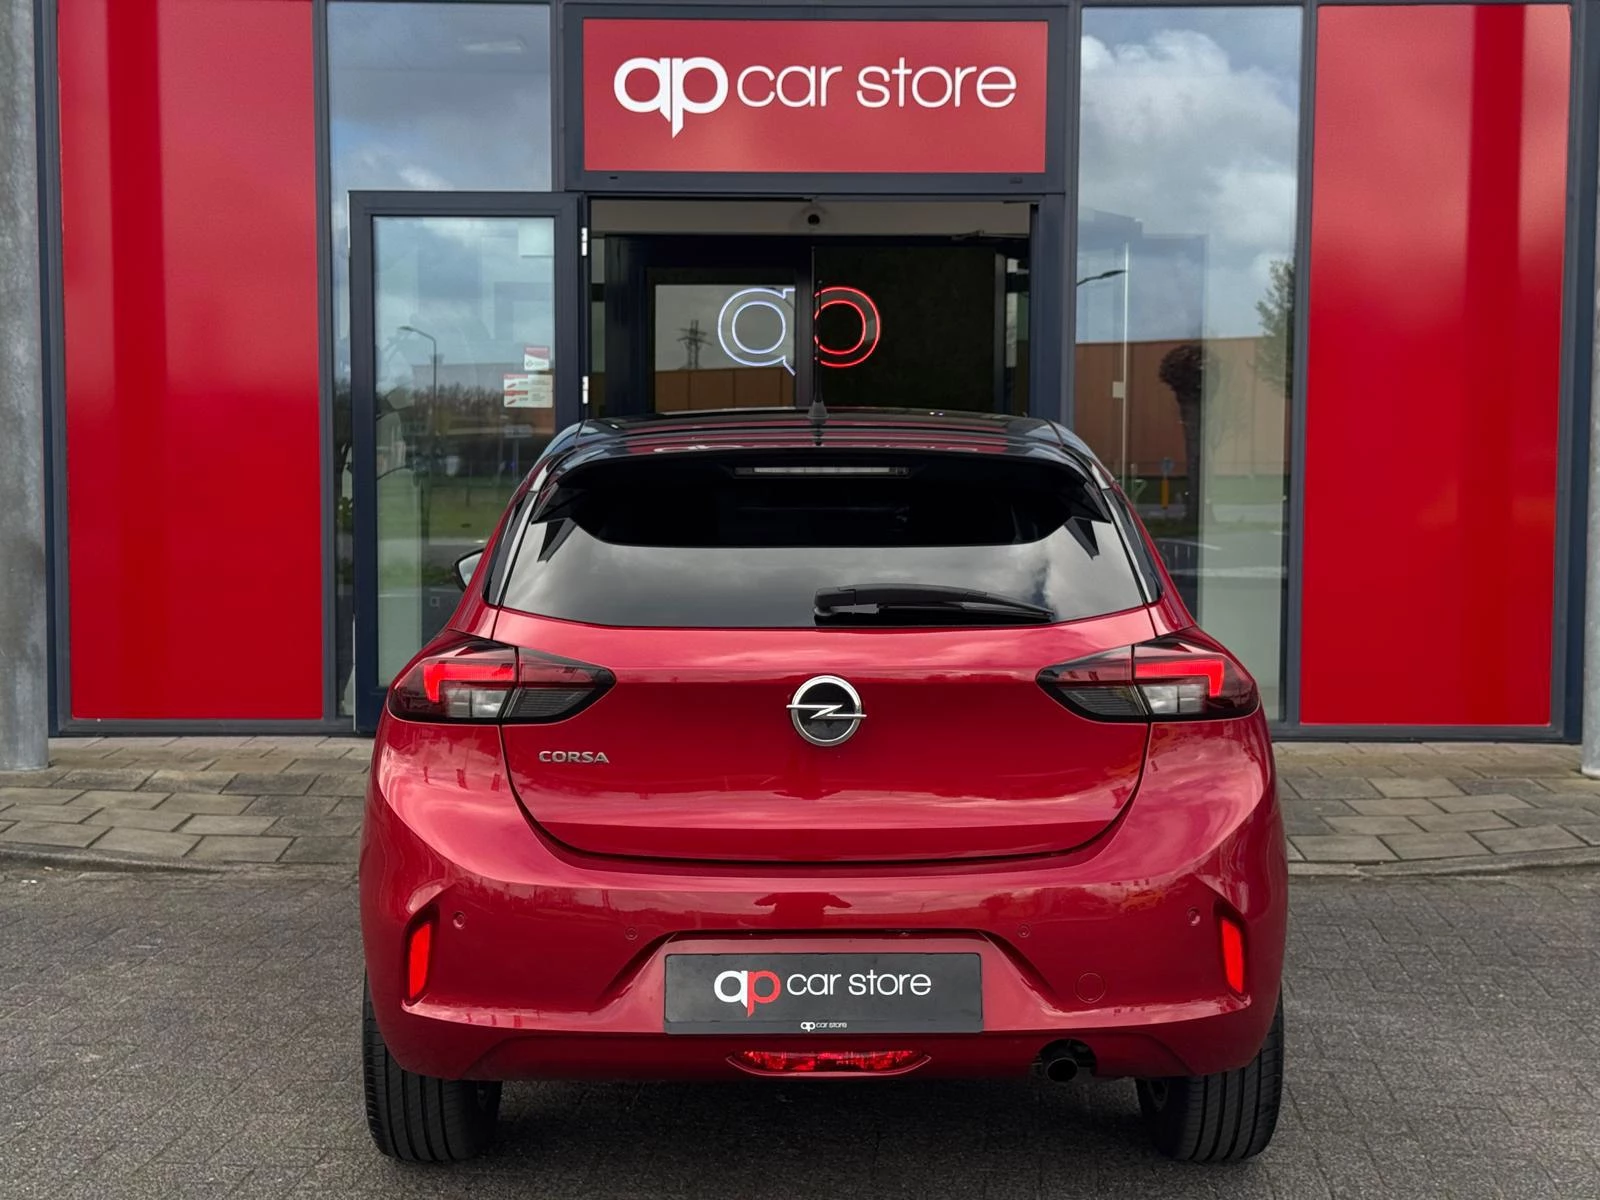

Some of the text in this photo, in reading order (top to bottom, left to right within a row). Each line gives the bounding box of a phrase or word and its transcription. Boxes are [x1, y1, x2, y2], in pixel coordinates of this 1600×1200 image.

[613, 56, 1017, 139] ap car store
[538, 750, 610, 764] CORSA
[713, 969, 932, 1017] ap car store
